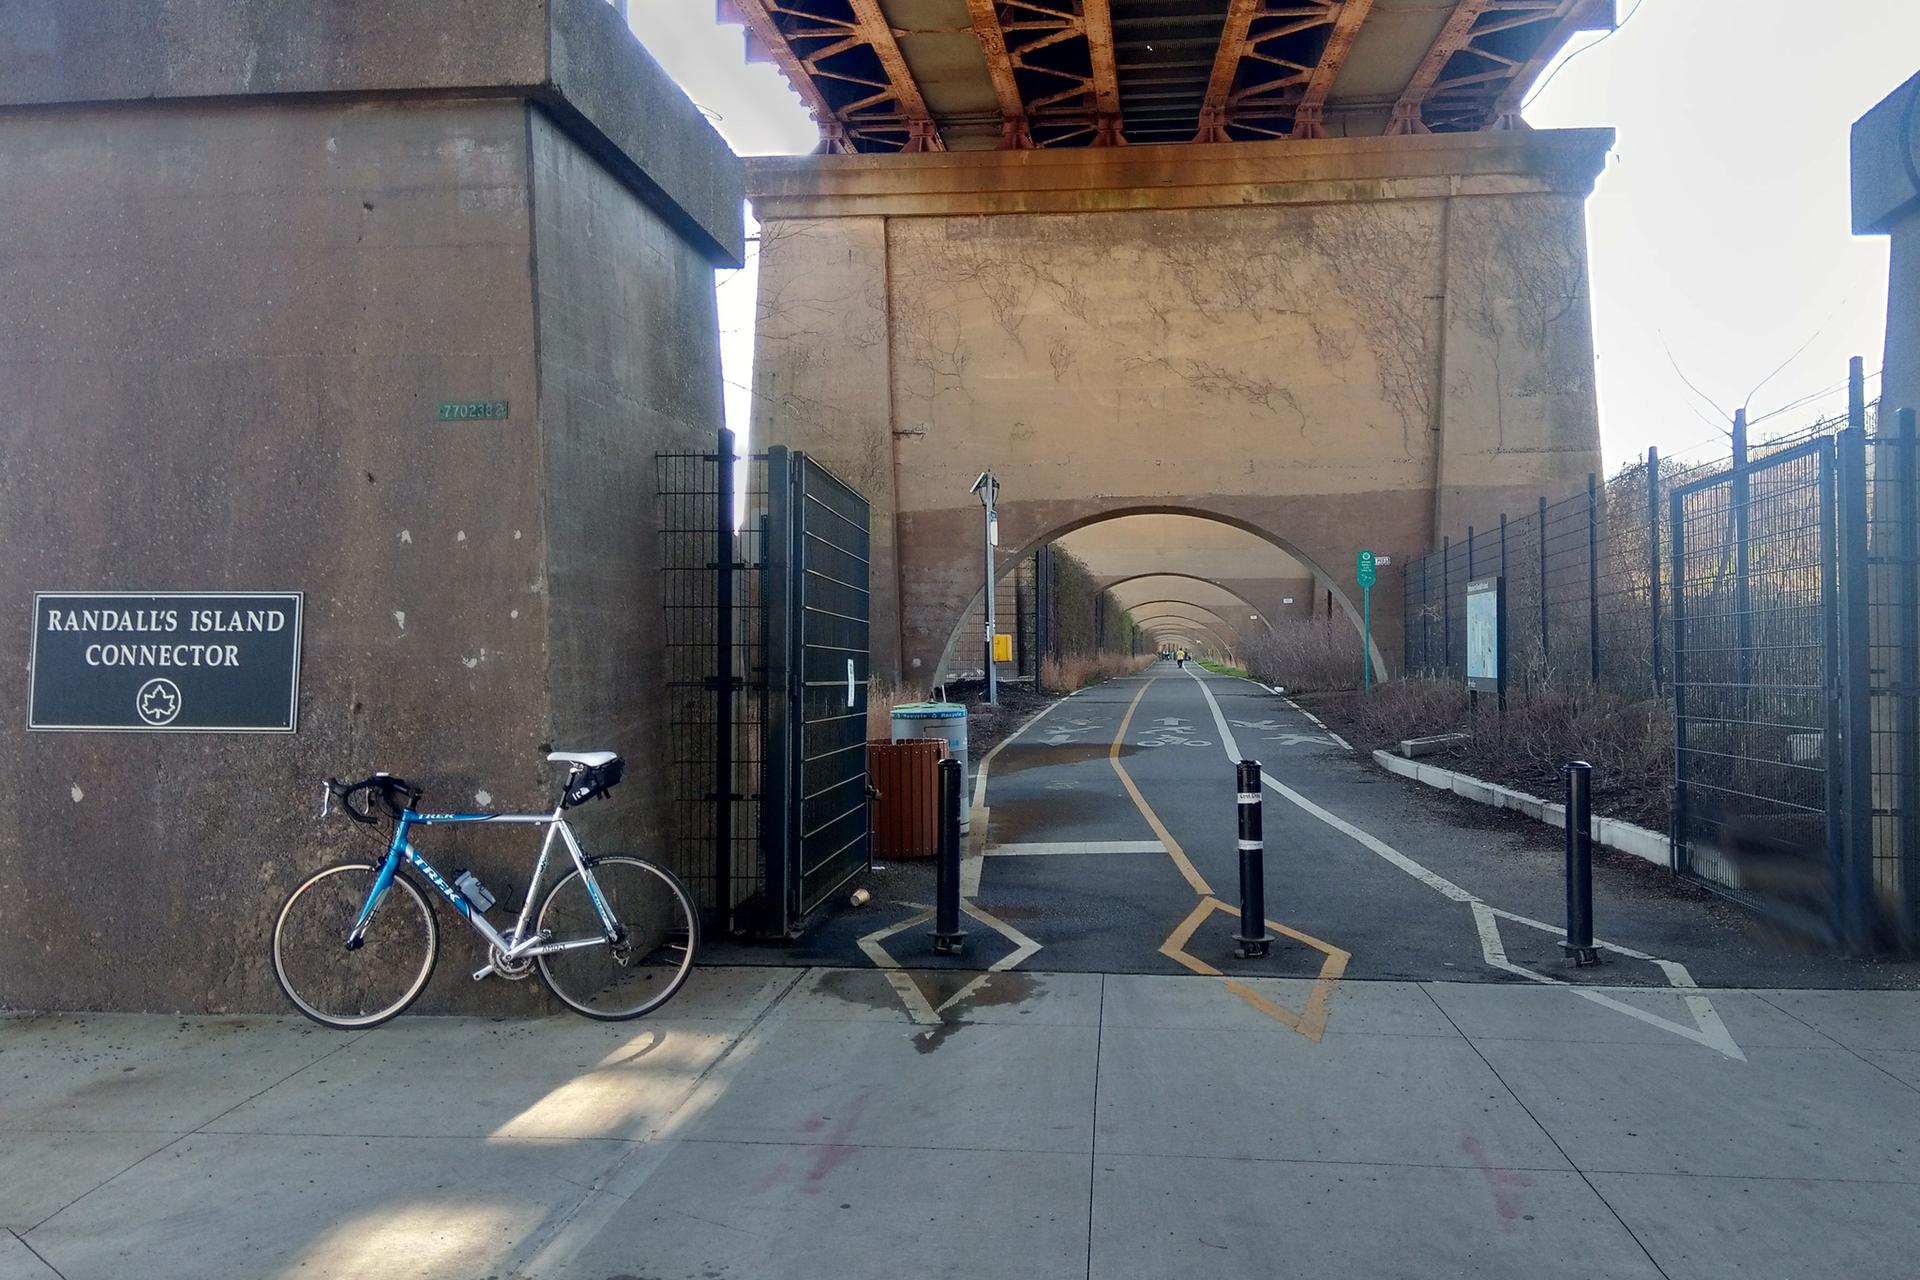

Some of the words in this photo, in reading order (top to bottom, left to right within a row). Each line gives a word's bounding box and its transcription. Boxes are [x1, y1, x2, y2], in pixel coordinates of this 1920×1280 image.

[47, 609, 178, 632] RANDALL'S
[189, 609, 285, 632] ISLAND
[85, 644, 239, 666] CONNECTOR
[414, 855, 461, 903] TREK
